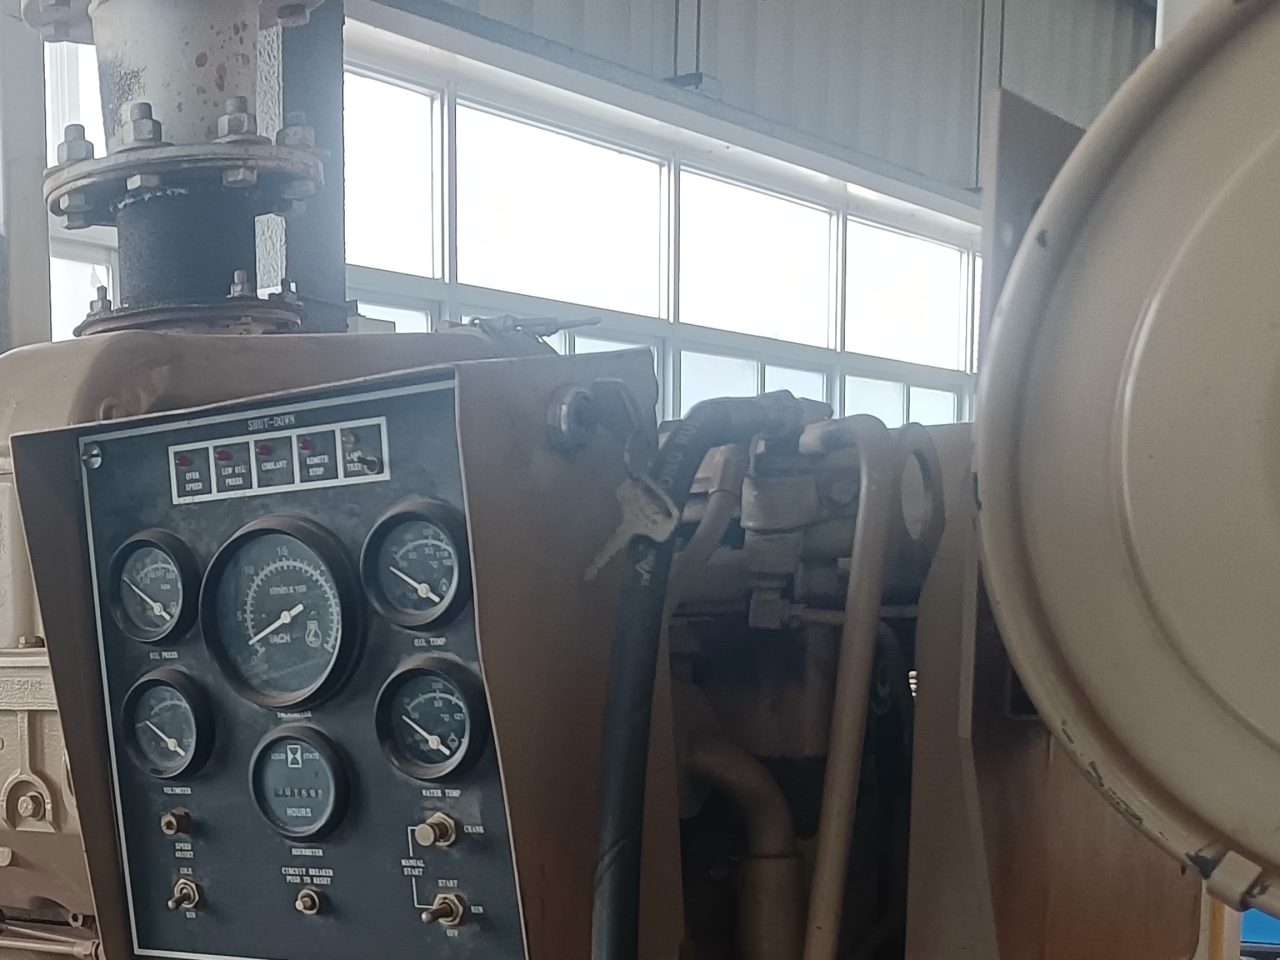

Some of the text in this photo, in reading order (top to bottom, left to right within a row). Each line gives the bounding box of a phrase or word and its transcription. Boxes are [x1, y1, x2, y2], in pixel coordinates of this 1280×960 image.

[247, 415, 296, 431] SHUT-DOWN
[261, 460, 288, 471] COOLANT
[185, 471, 200, 481] OVER
[221, 466, 234, 476] LOW
[286, 807, 312, 817] HOURS
